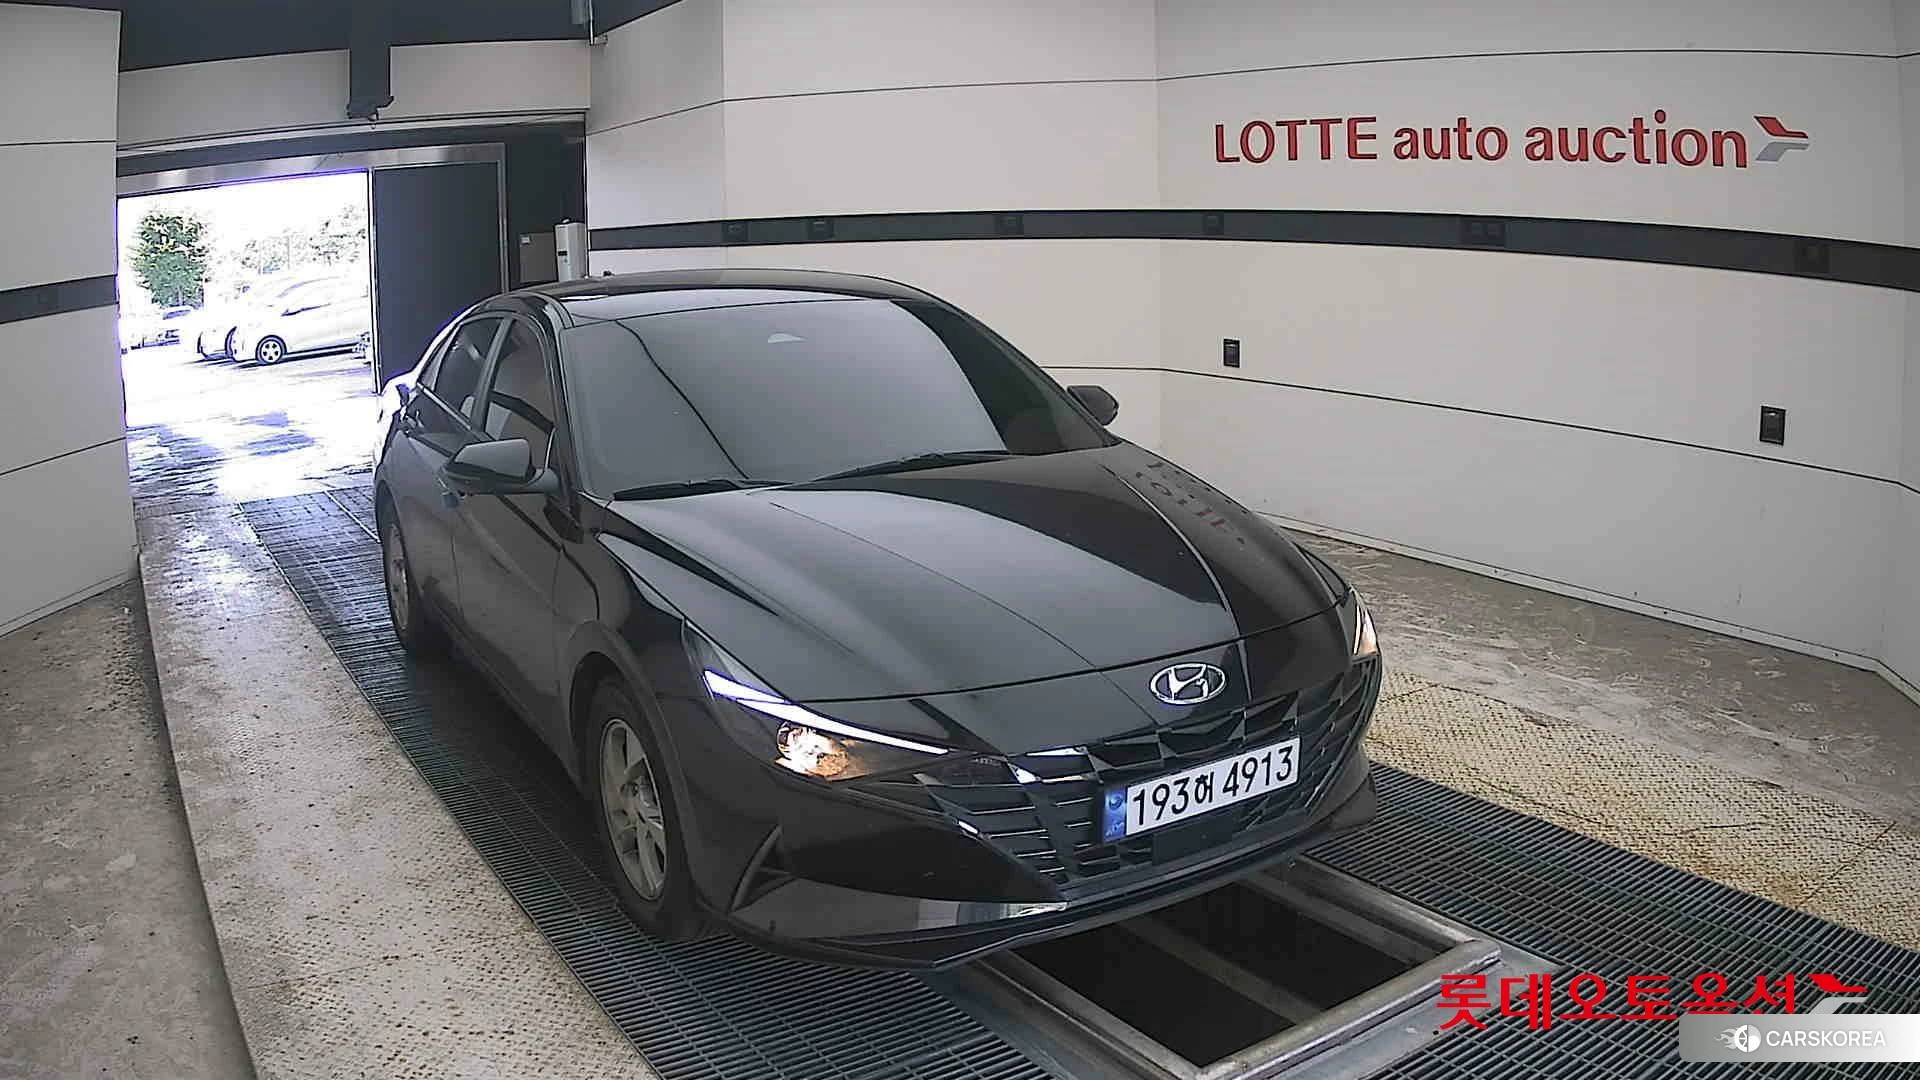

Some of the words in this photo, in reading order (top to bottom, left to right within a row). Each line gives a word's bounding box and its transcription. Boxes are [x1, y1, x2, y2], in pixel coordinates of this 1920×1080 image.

[1214, 116, 1378, 163] LOTTE
[1393, 117, 1509, 162] auto
[1524, 110, 1749, 169] auction
[1132, 770, 1215, 826] 193허
[1222, 745, 1294, 798] 4913
